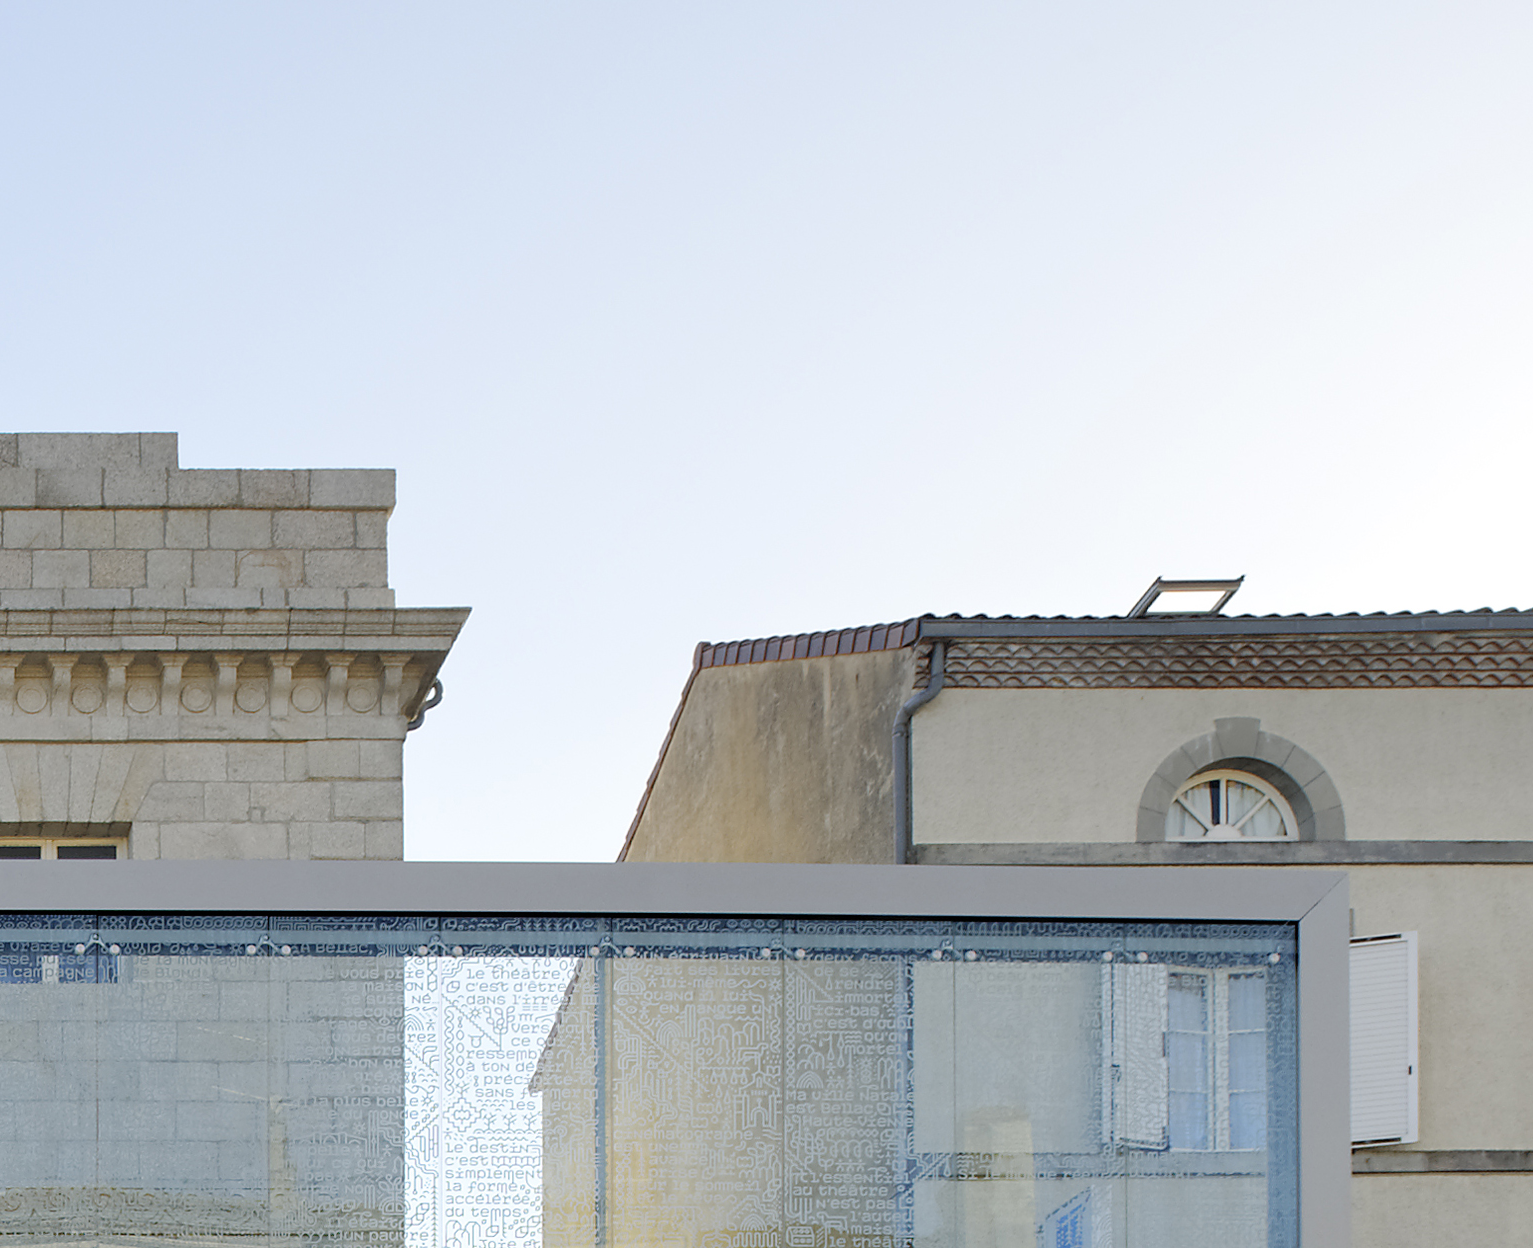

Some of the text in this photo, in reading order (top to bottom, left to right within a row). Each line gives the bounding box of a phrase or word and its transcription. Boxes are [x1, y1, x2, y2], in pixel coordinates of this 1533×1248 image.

[340, 969, 379, 979] vous
[466, 967, 485, 979] le
[688, 965, 718, 976] ses
[725, 964, 781, 976] livres
[466, 981, 566, 992] c'est d'être
[511, 1023, 550, 1034] vers
[813, 1018, 858, 1029] c'est
[510, 1037, 531, 1047] ce
[466, 1049, 554, 1060] ressemble
[465, 1061, 476, 1072] à
[334, 1095, 372, 1109] plus
[377, 1095, 420, 1107] belle
[510, 1100, 536, 1111] les
[786, 1103, 815, 1114] est
[445, 1142, 464, 1153] le
[444, 1156, 488, 1166] c'est
[445, 1181, 462, 1191] la
[793, 1184, 888, 1196] au théâtre
[445, 1194, 530, 1205] accélérée
[866, 1199, 896, 1213] pas
[445, 1207, 522, 1219] du temps
[369, 1231, 429, 1243] pauvre
[829, 1236, 846, 1247] le
